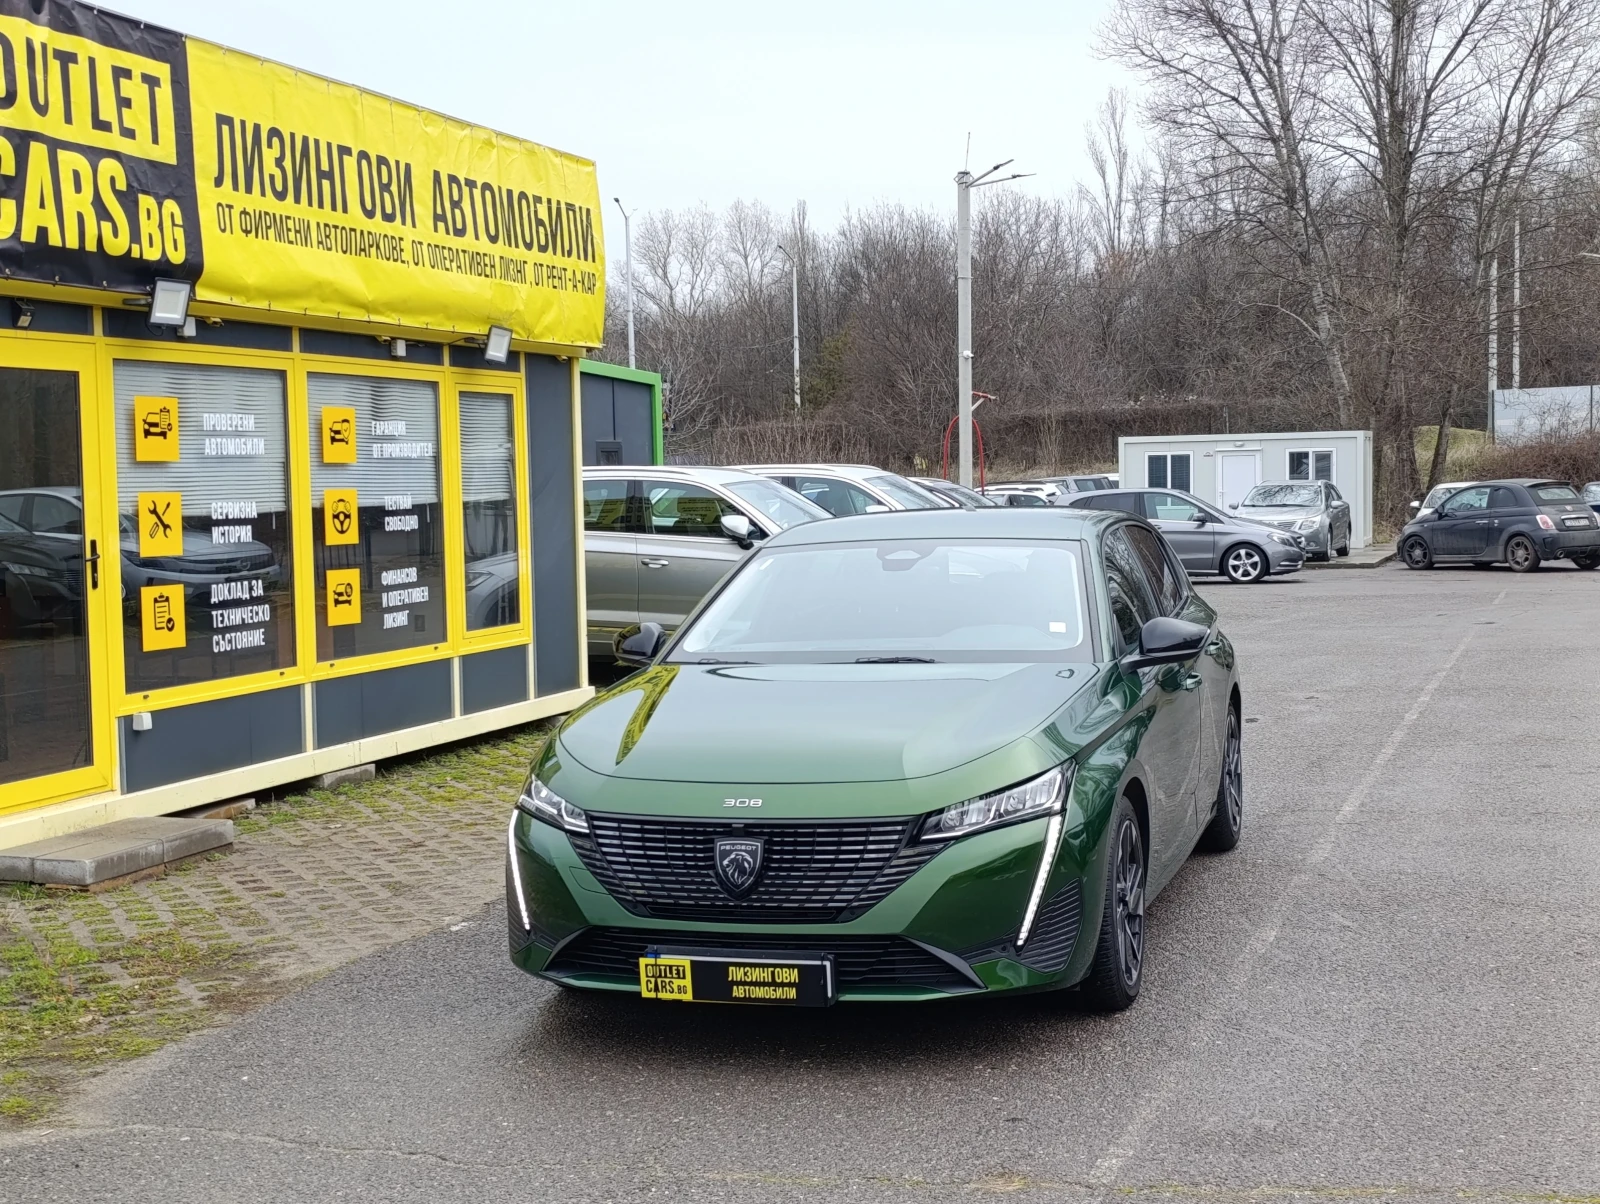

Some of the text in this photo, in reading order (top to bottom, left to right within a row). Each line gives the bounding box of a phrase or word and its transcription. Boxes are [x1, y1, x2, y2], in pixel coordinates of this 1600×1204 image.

[214, 112, 597, 264] ЛИЗИНГОВИ АВТОМОБИЛИ
[216, 202, 235, 235] ОТ
[239, 207, 314, 249] ФИРМЕНИ
[316, 221, 410, 269] АВТОПАРКОВЕ,
[412, 239, 426, 268] ОТ
[427, 242, 497, 280] ОПЕРАТИВЕН
[546, 263, 597, 296] РЕНТ-А-КАР
[203, 413, 255, 431] ПРОВЕРЕНИ
[204, 437, 265, 456] АВТОМОБИЛИ
[210, 501, 257, 520] СЕРВИЗНА
[384, 493, 413, 511] ТЕСТВАЙ
[384, 515, 419, 532] СВОБОДНО
[211, 525, 253, 545] ИСТОРИЯ
[381, 567, 418, 586] ФИНАНСОВ
[210, 579, 264, 603] ДОКЛАД ЗА
[388, 586, 428, 606] ОПЕРАТИВЕН
[211, 604, 271, 629] ТЕХНИЧЕСКО
[383, 610, 409, 630] ЛИЗИНГ
[212, 628, 266, 653] СЪСТОЯНИЕ
[723, 798, 763, 808] 308
[646, 965, 685, 978] OUTLET
[728, 966, 799, 984] ЛИЗИНГОВИ
[645, 979, 688, 995] CARS.BG
[732, 985, 797, 1000] АВТОМОБИЛИ
